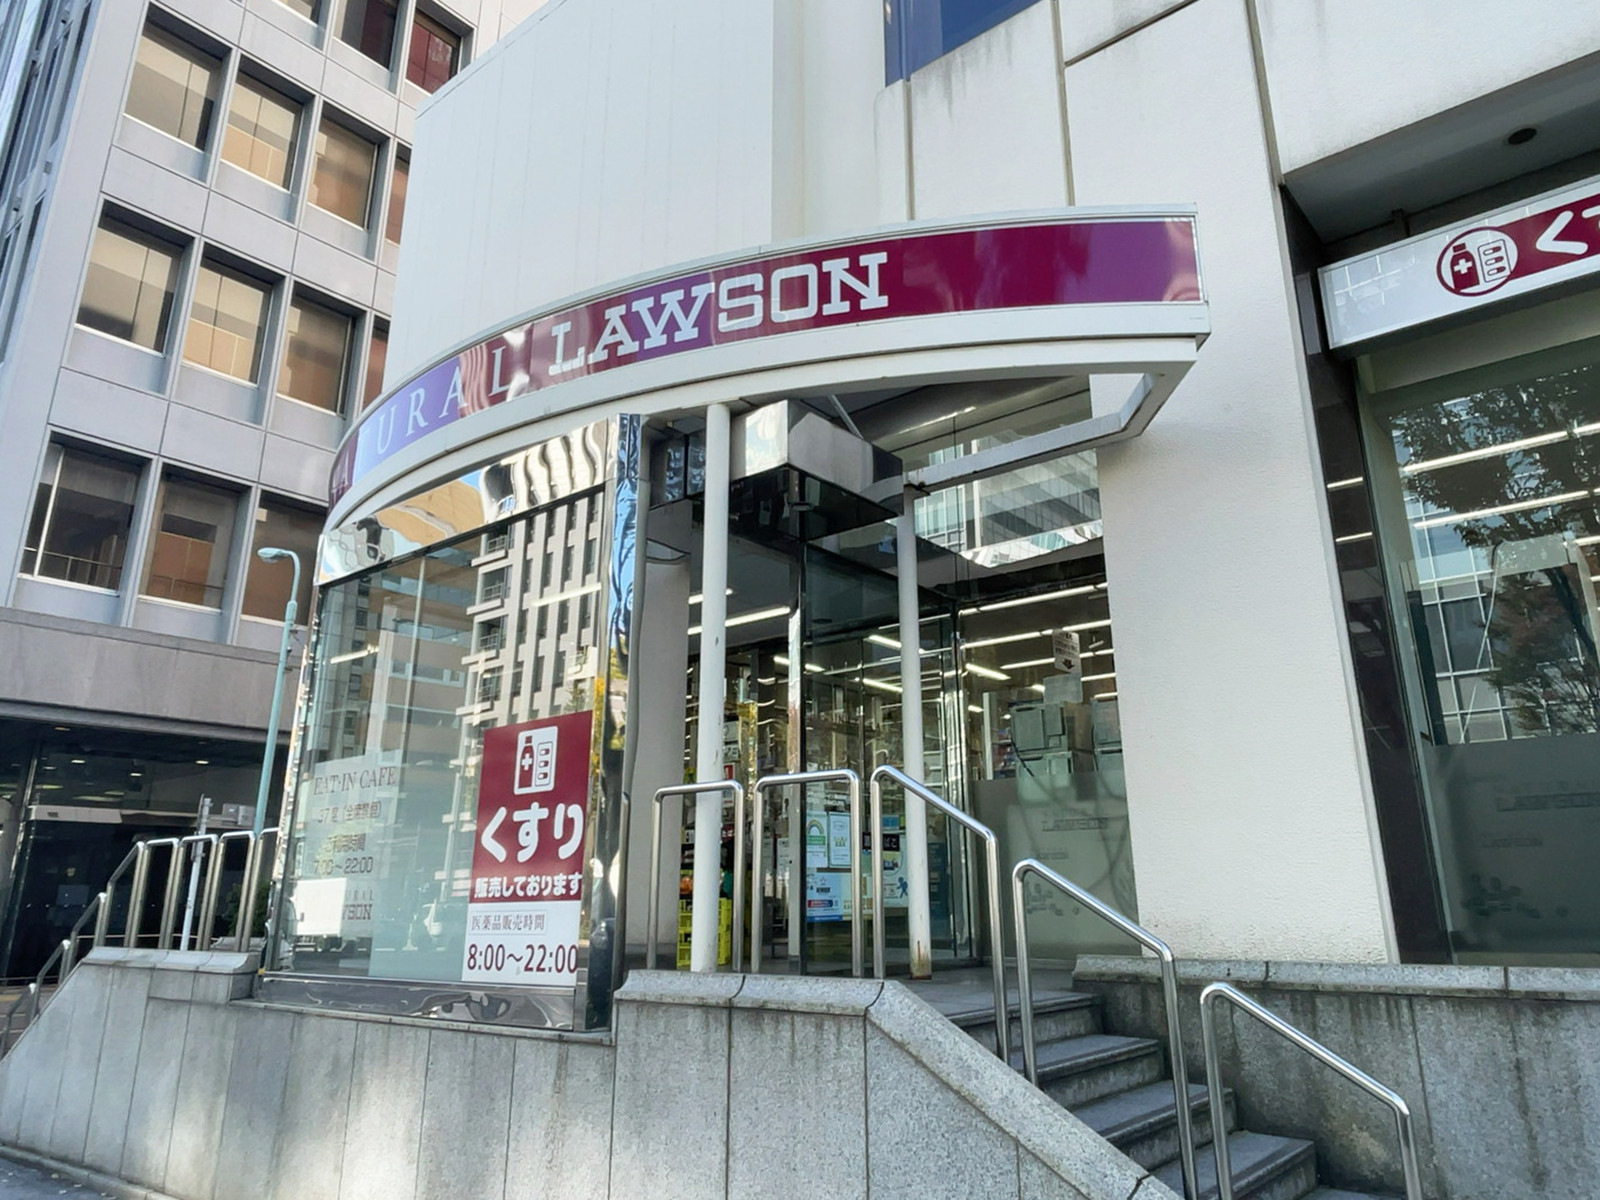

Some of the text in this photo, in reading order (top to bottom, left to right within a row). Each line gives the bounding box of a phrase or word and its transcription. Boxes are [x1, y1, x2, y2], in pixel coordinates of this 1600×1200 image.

[1535, 205, 1600, 255] く
[547, 252, 889, 375] LAWSON
[360, 766, 396, 789] CAFE
[480, 802, 585, 864] くすり
[474, 872, 583, 898] 販売しております
[471, 914, 546, 931] 医薬品販売時間
